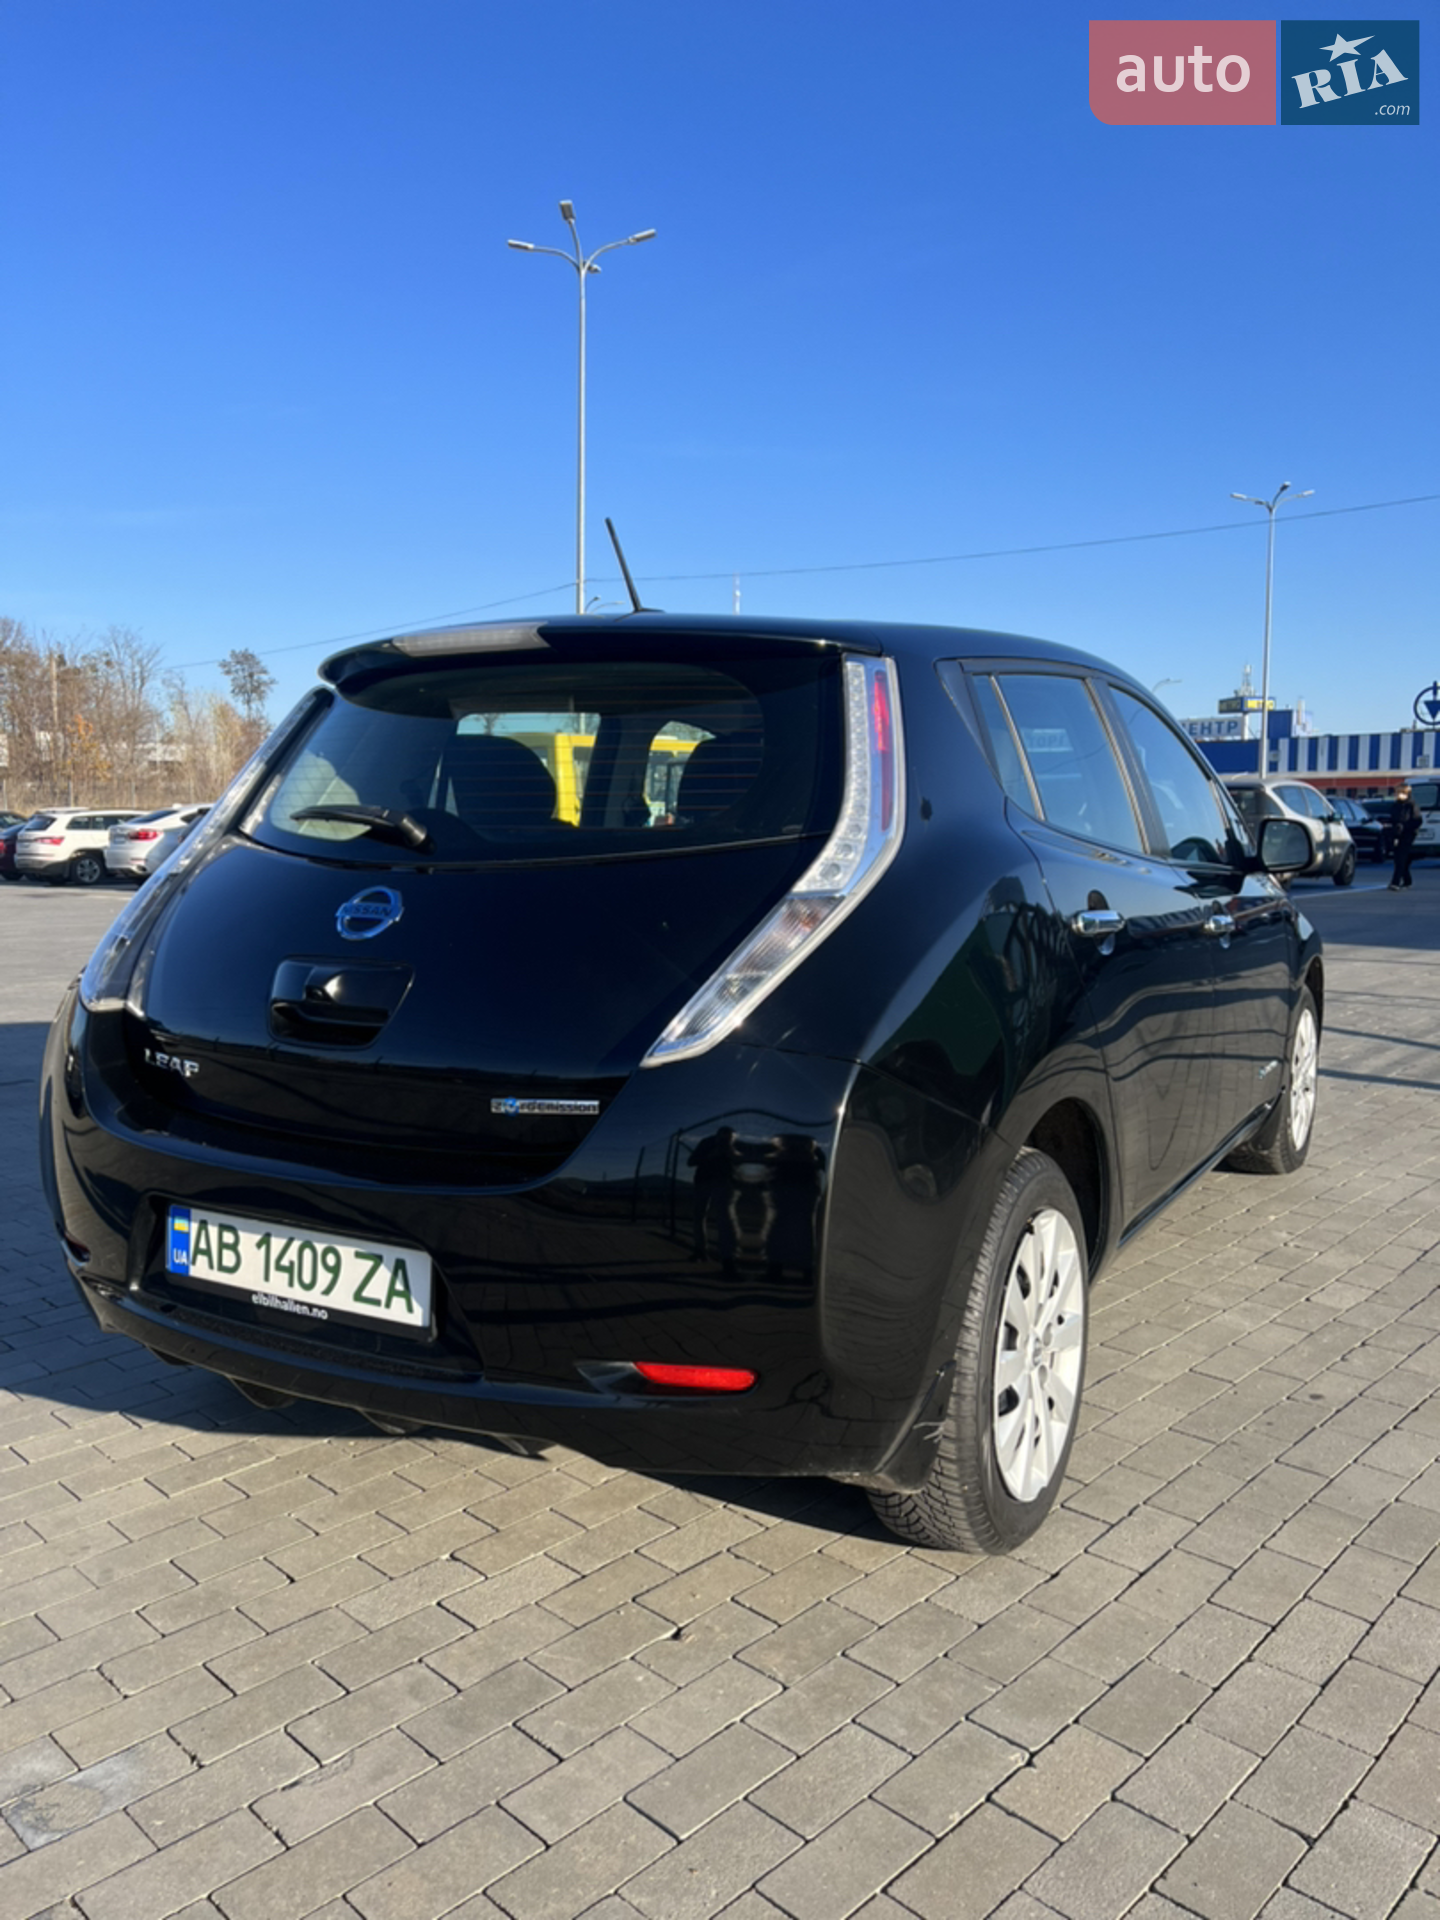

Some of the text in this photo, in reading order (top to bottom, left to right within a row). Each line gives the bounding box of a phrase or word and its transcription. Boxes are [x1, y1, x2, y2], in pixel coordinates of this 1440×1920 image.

[173, 1247, 188, 1265] UA
[191, 1219, 415, 1314] AB 1409 ZA
